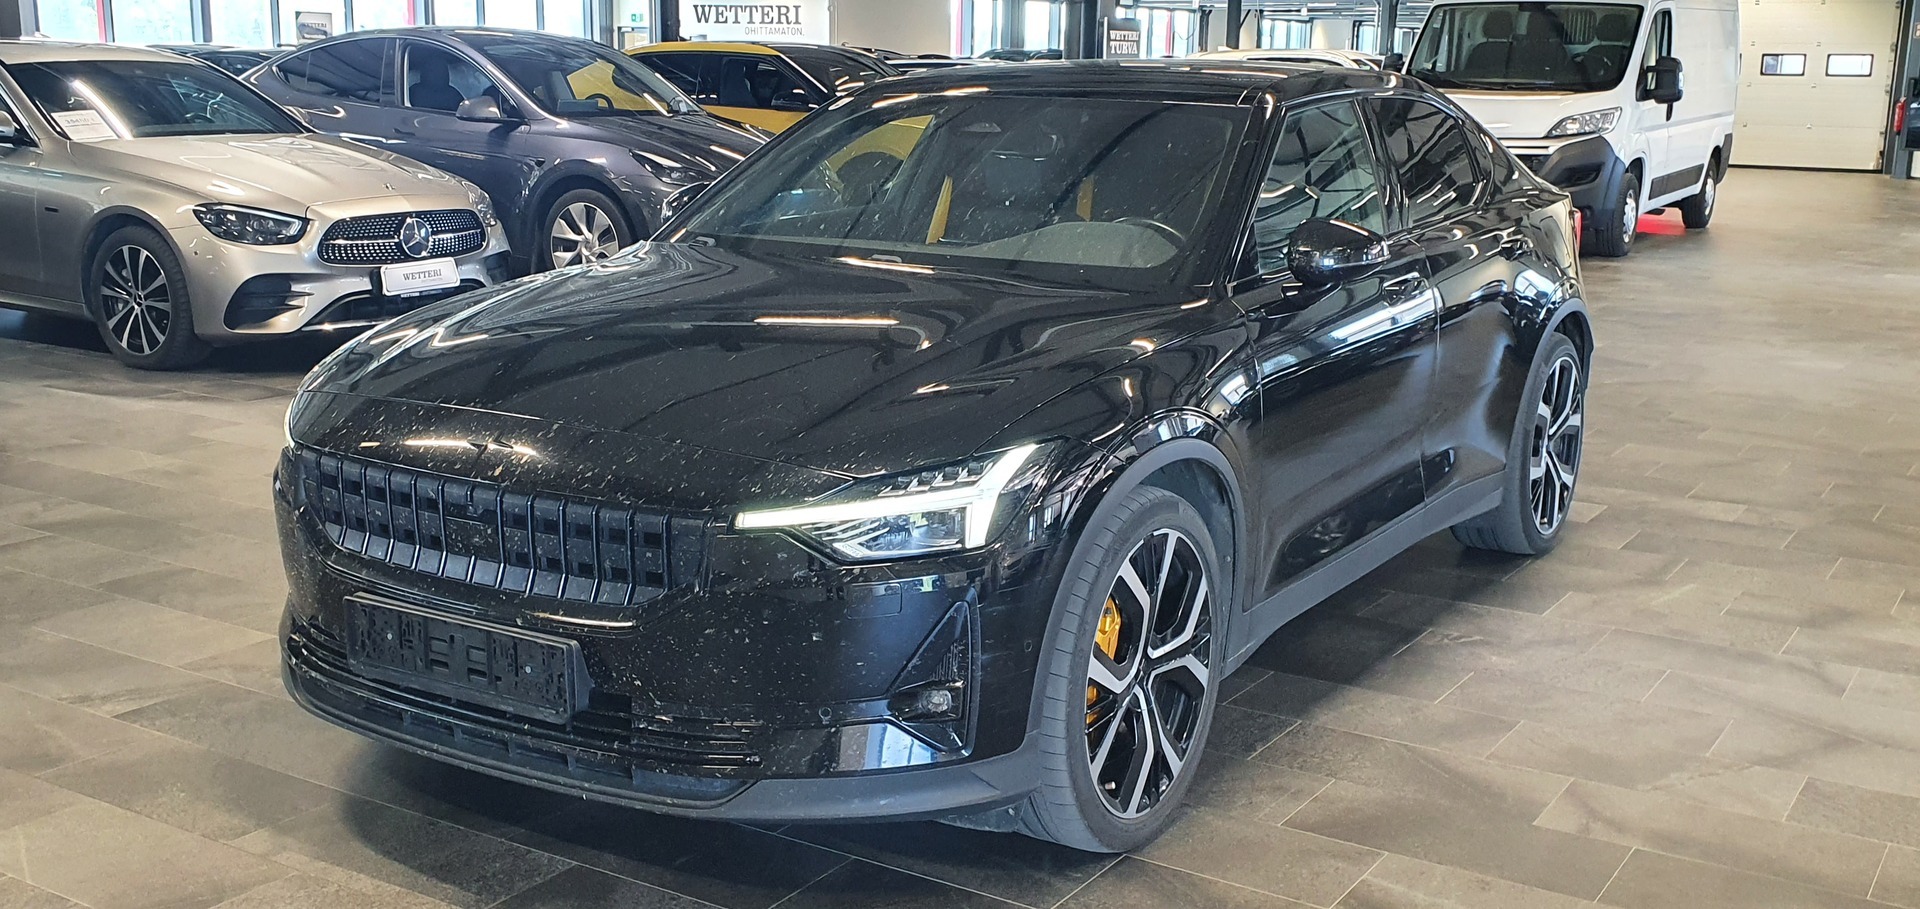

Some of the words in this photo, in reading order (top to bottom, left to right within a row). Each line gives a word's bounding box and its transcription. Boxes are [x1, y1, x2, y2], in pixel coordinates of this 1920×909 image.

[693, 4, 802, 25] WETTERI
[1109, 30, 1140, 41] WETTERI
[1109, 41, 1138, 54] TURVA
[402, 268, 442, 281] WETTERI
